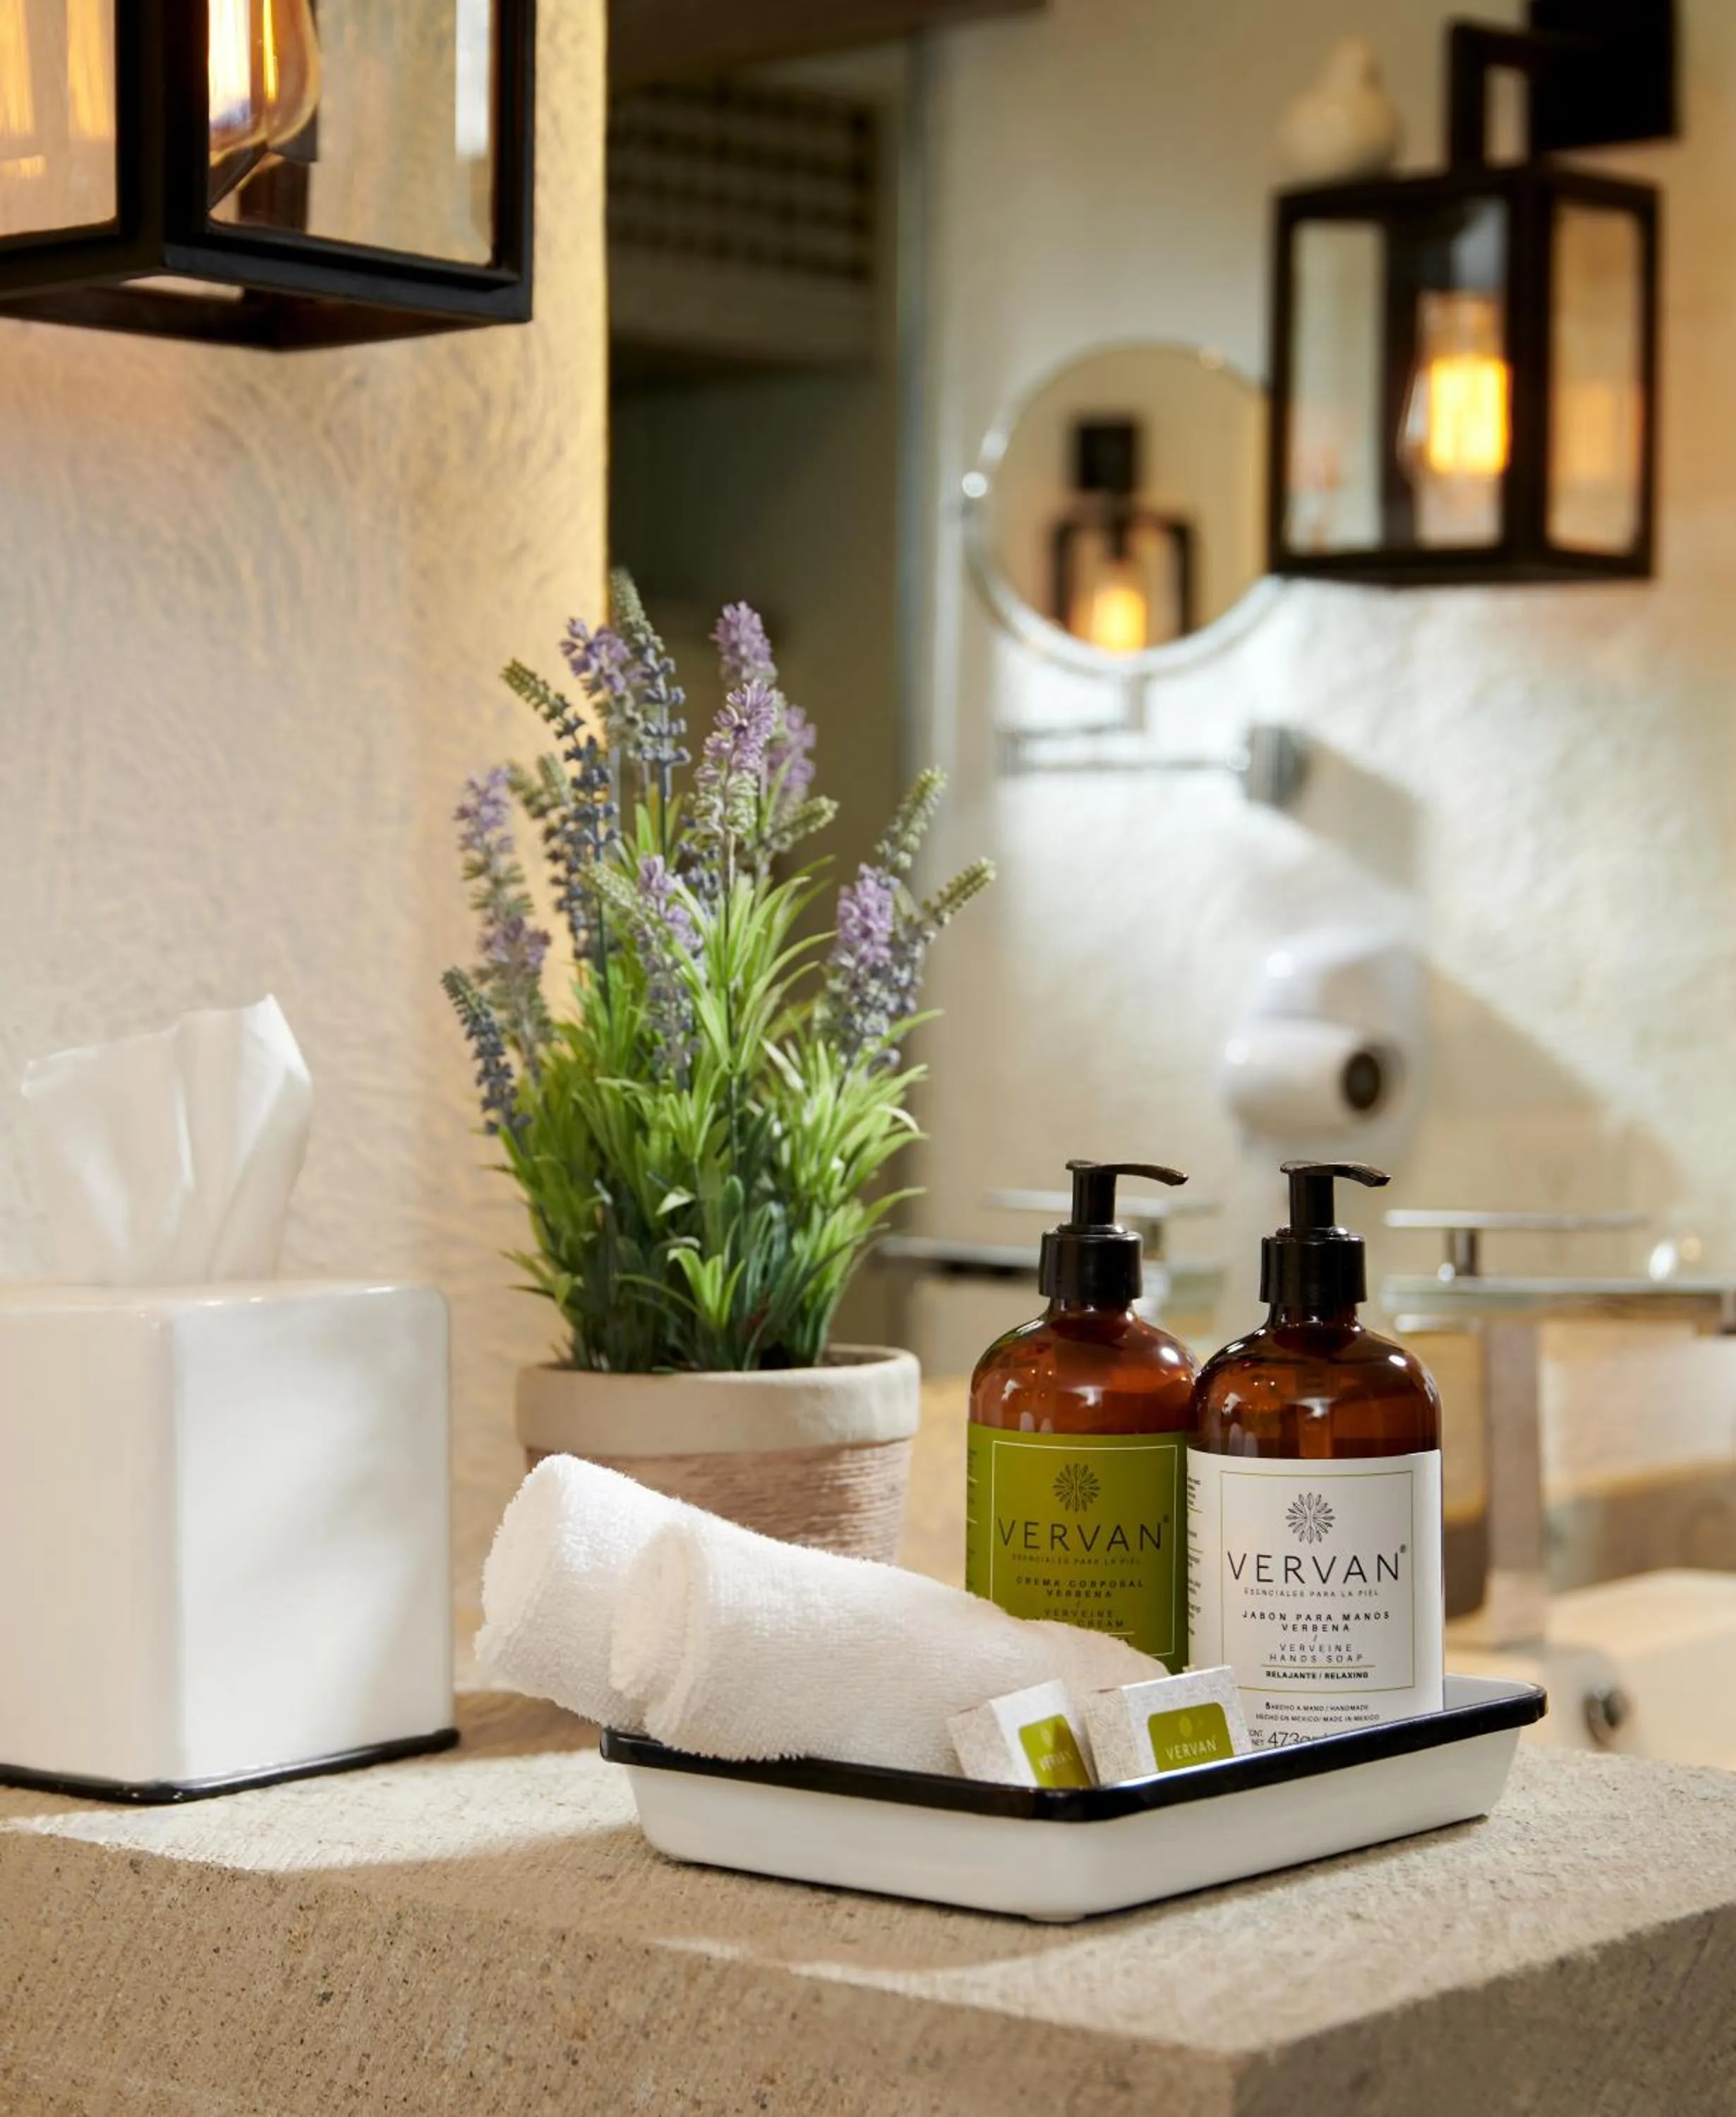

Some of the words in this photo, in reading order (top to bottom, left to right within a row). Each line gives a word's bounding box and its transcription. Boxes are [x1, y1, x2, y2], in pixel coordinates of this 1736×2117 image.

[998, 1518, 1162, 1552] VERVAN
[1011, 1554, 1070, 1564] ESENCIALES
[1074, 1557, 1099, 1566] PARA
[1227, 1551, 1399, 1584] VERVAN
[1015, 1576, 1060, 1586] CREMA
[1068, 1580, 1144, 1588] CORPORAL
[1046, 1589, 1113, 1598] VERBENA
[1243, 1588, 1305, 1598] ESENCIALES
[1044, 1609, 1114, 1618] VERVEINE
[1342, 1611, 1390, 1622] MANOS
[1077, 1619, 1125, 1628] CREAM
[1282, 1624, 1351, 1632] VERBENA
[1279, 1643, 1353, 1653] VERVEINE
[1269, 1653, 1317, 1663] HANDS
[1327, 1654, 1363, 1663] SOAP
[1265, 1670, 1316, 1679] RELAJANTE
[1325, 1670, 1369, 1679] RELAXING
[1164, 1739, 1217, 1761] VERVAN
